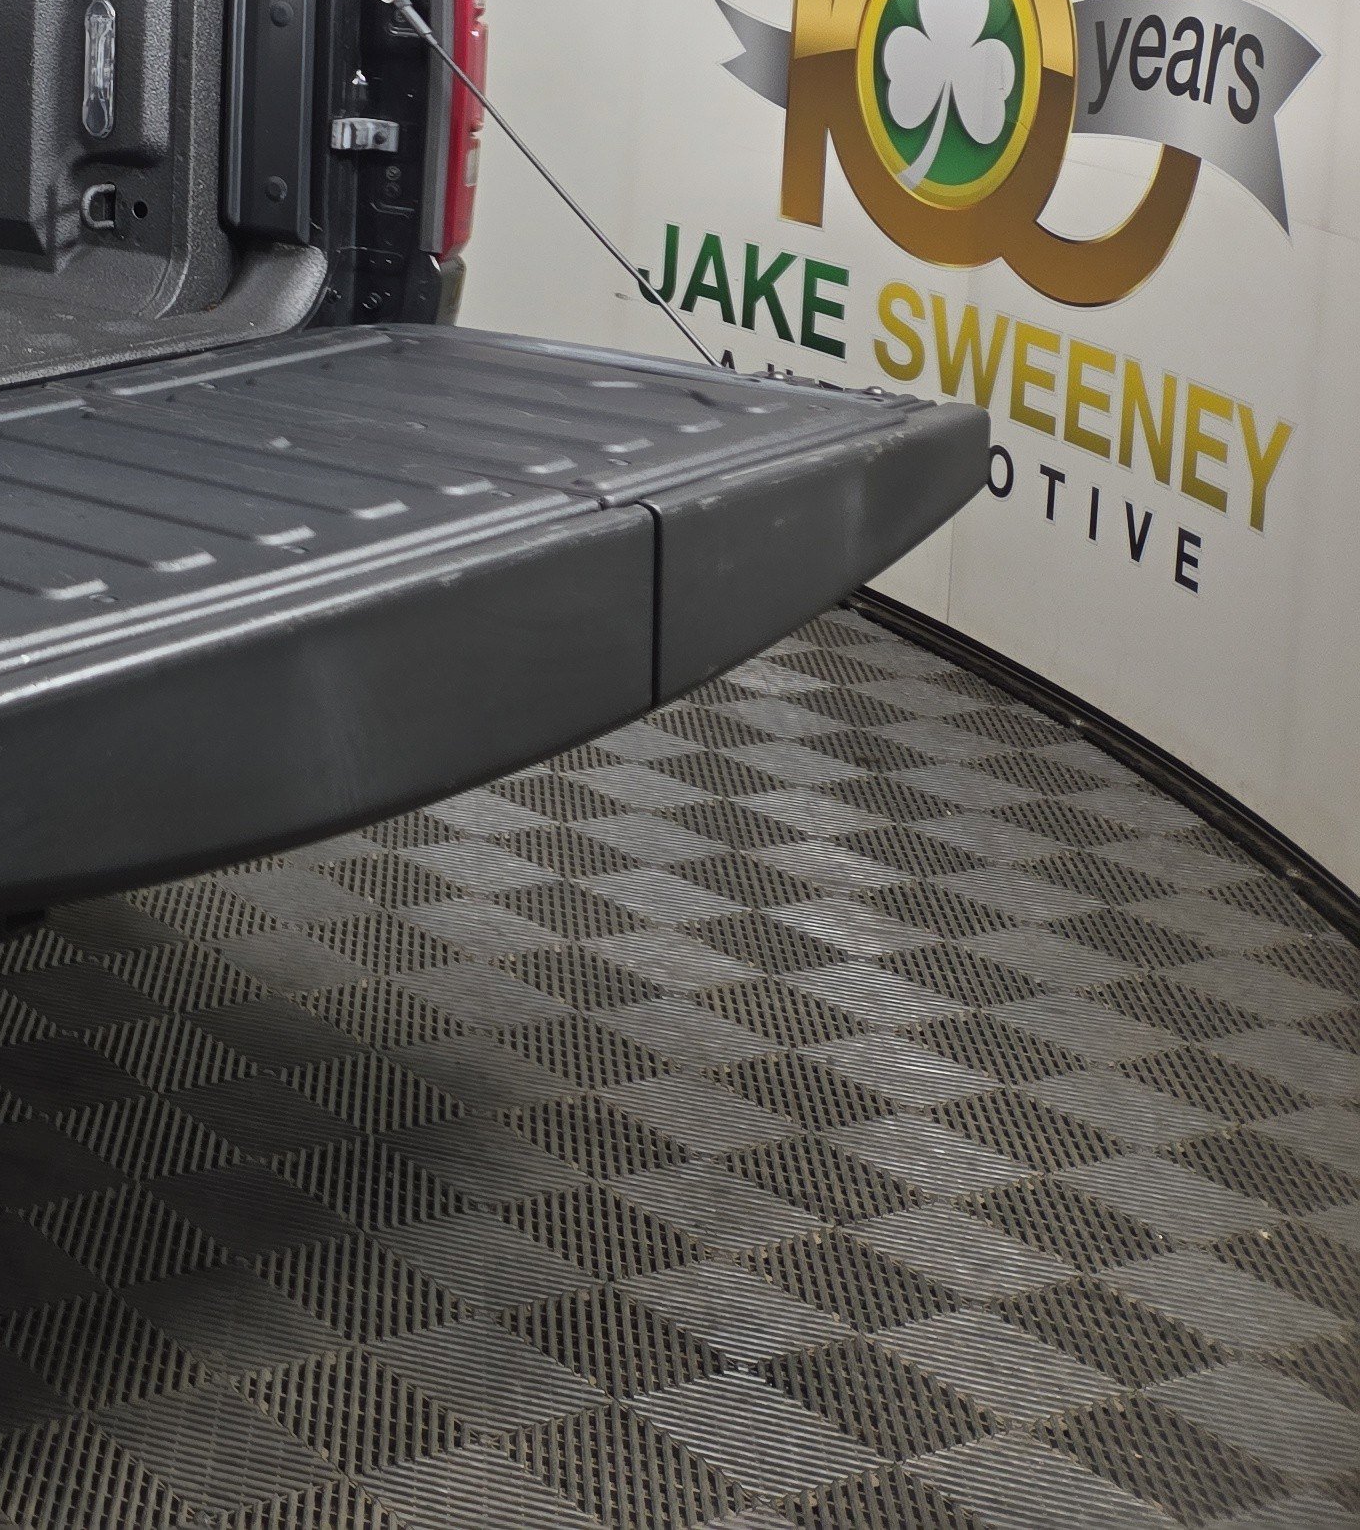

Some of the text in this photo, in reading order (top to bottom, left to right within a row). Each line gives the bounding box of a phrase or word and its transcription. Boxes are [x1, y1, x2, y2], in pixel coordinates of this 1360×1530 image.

[1087, 14, 1265, 125] years
[637, 223, 1292, 532] JAKE SWEENEY
